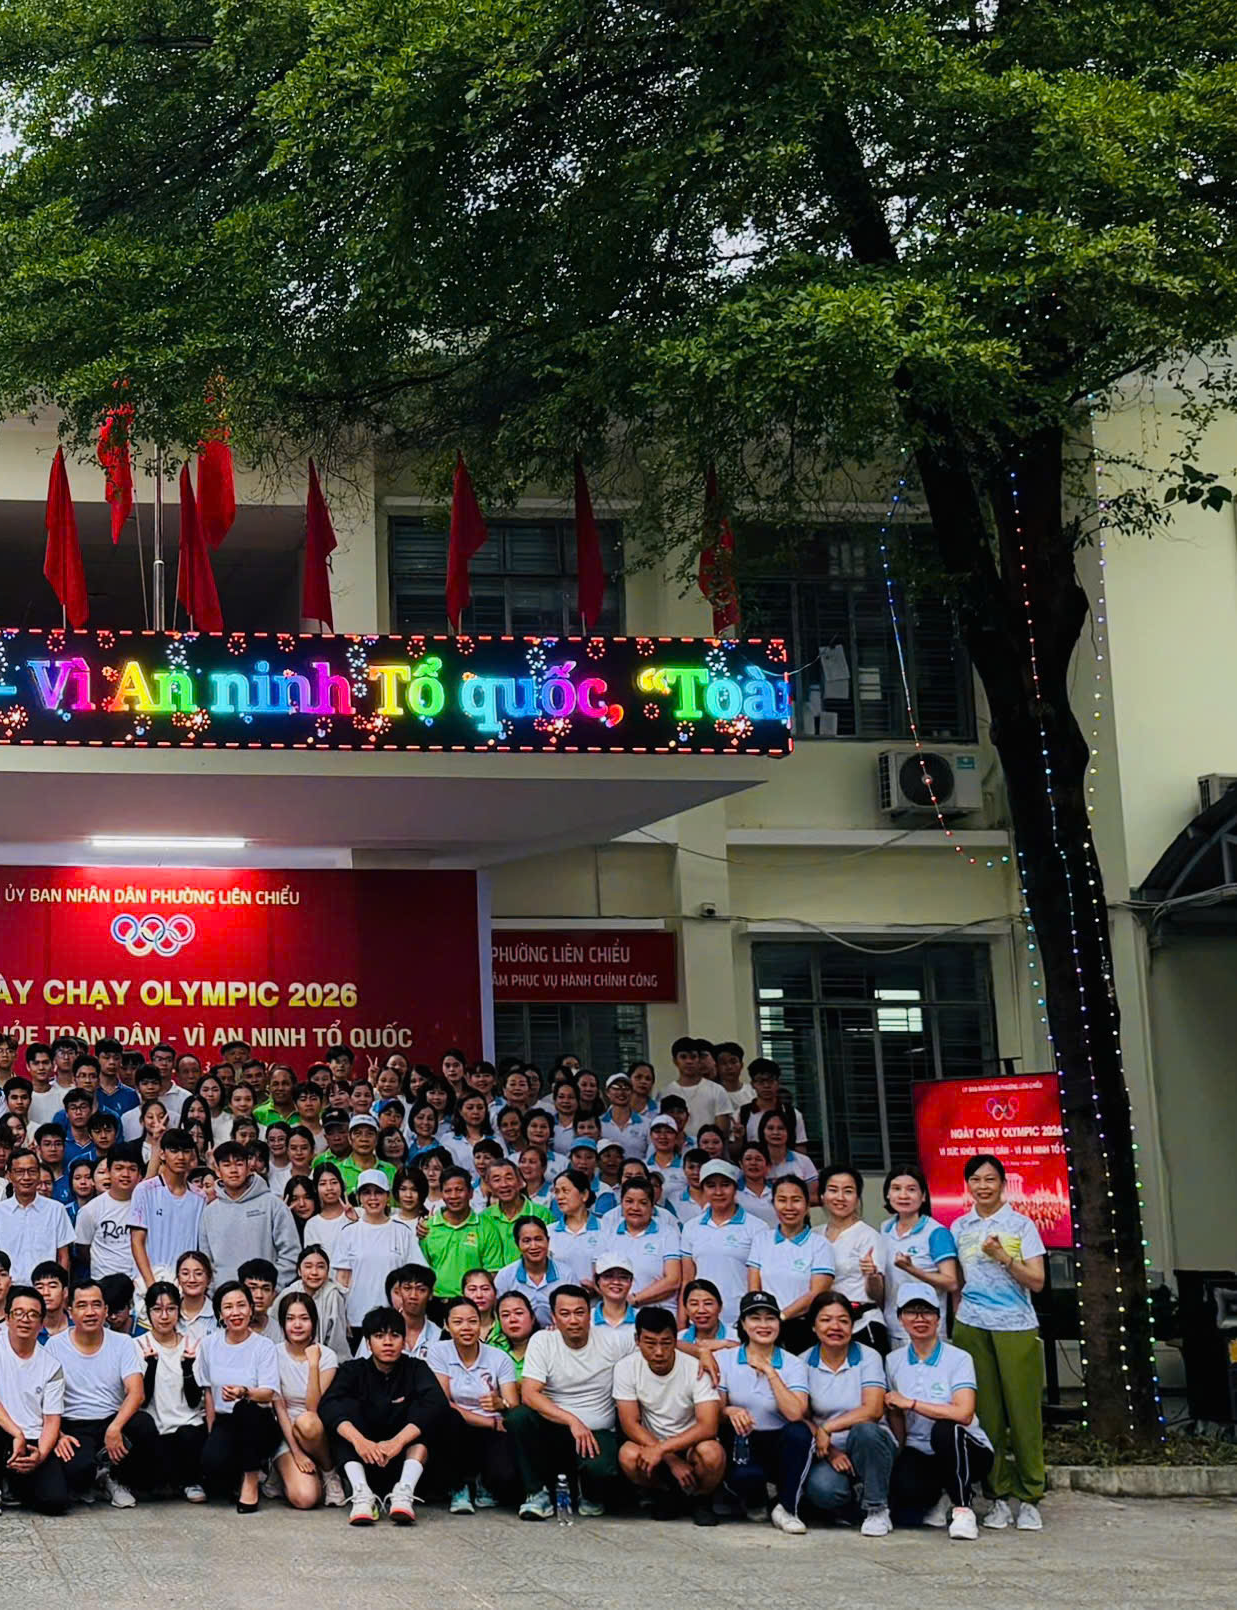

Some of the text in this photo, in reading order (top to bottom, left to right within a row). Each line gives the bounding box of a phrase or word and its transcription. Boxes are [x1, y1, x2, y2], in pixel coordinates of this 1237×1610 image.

[28, 657, 95, 711] Vì
[114, 660, 196, 712] An
[210, 660, 355, 715] ninh
[369, 657, 444, 715] Tổ
[461, 660, 623, 733] quốc,
[5, 883, 300, 905] ỦY BAN NHÂN DÂN PHƯỜNG LIÊN CHIỂU
[553, 942, 584, 963] LIÊN
[589, 938, 630, 963] CHIỂU
[512, 974, 540, 988] PHỤC
[543, 974, 558, 989] VỤ
[561, 971, 591, 987] HÀNH
[594, 972, 627, 987] CHÍNH
[630, 972, 658, 987] CÔNG
[43, 980, 132, 1010] CHẠY
[140, 980, 279, 1007] OLYMPIC
[288, 982, 358, 1007] 2026
[114, 1021, 161, 1046] DÂN
[183, 1022, 205, 1047] VÌ
[212, 1027, 243, 1047] AN
[251, 1027, 306, 1047] NINH
[312, 1019, 342, 1047] TỔ
[350, 1021, 413, 1048] QUỐC
